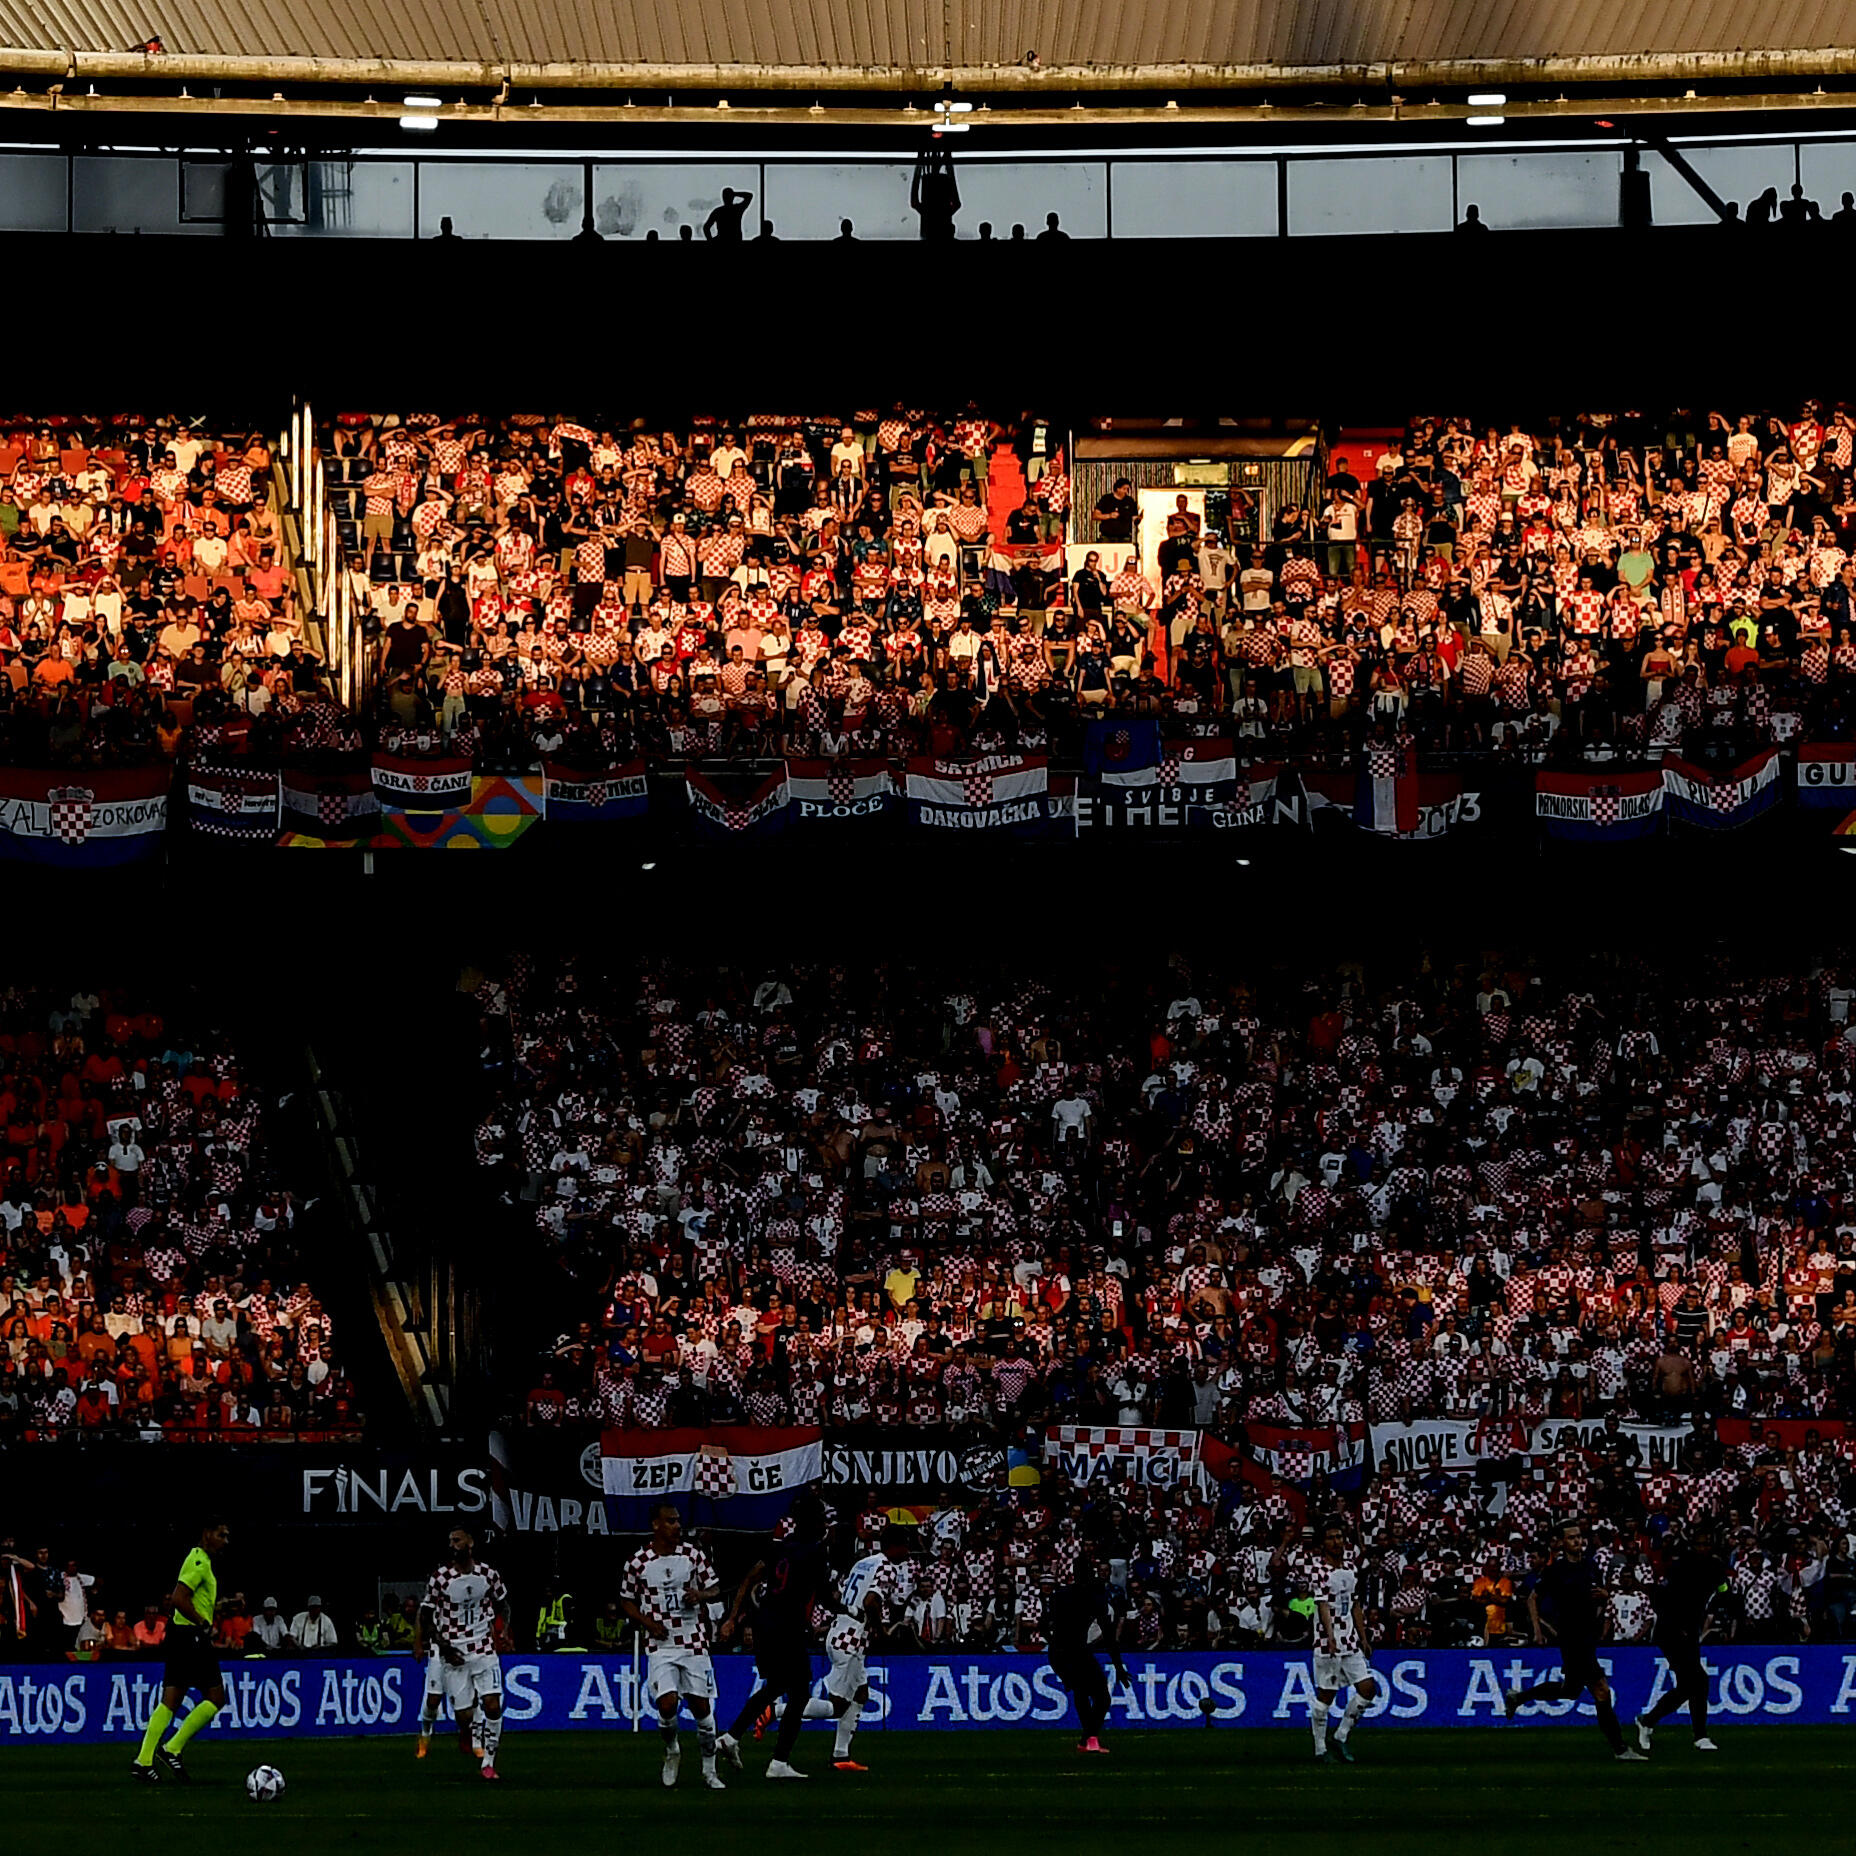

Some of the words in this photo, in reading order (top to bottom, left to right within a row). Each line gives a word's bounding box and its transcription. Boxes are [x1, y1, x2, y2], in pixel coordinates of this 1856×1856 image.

[799, 795, 884, 819] PLOČE
[919, 799, 1042, 830] ĐAKOVAČKA
[1212, 804, 1266, 829] GLINA
[302, 1464, 489, 1513] FINALS
[665, 1593, 679, 1611] 21
